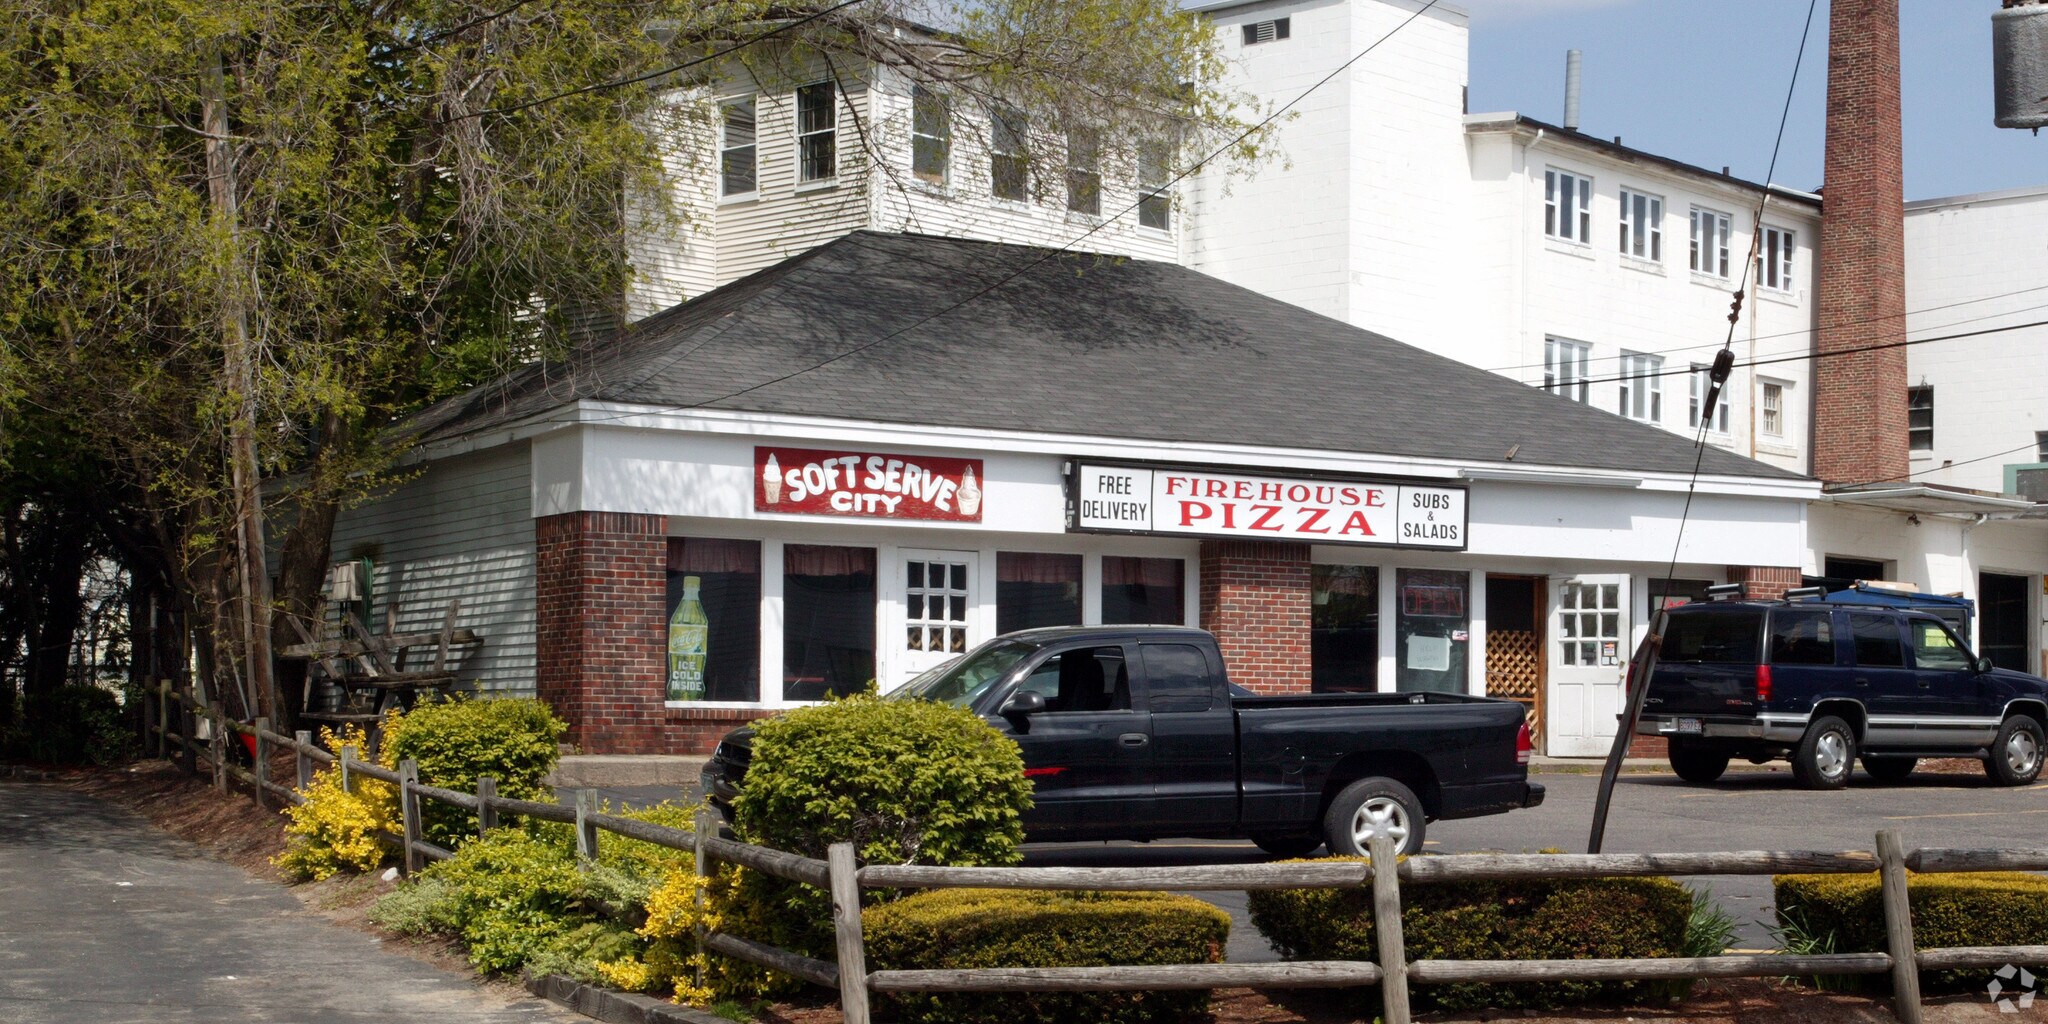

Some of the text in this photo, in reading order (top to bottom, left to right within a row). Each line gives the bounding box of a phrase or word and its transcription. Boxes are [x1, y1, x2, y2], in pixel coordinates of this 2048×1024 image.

[785, 456, 957, 512] SOFT SERVE
[1098, 475, 1132, 495] FREE
[1165, 476, 1386, 508] FIREHOUSE
[830, 491, 902, 513] CITY
[1083, 500, 1147, 521] DELIVERY
[1413, 492, 1450, 509] SUBS
[1178, 501, 1377, 536] PIZZA
[1427, 511, 1434, 521] &
[1403, 522, 1457, 540] SALADS
[1406, 589, 1462, 614] OPEN
[672, 671, 700, 680] COLD
[678, 661, 696, 670] ICE
[671, 681, 702, 691] INSIDE
